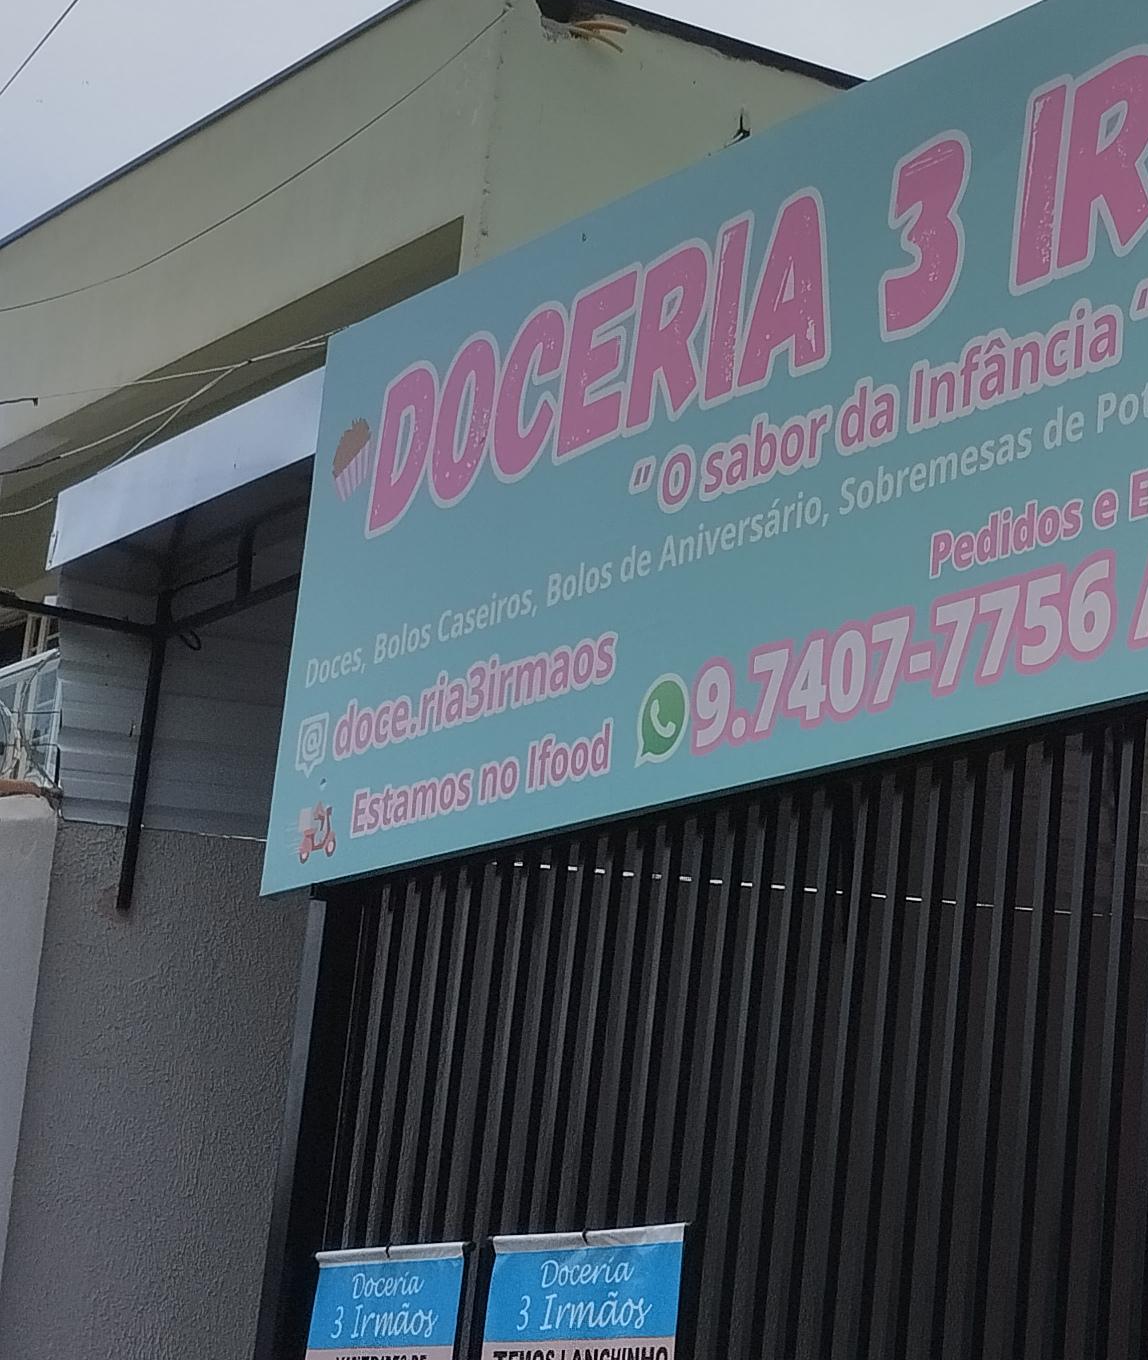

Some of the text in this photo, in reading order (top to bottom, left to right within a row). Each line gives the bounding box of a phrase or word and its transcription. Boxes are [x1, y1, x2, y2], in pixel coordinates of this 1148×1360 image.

[366, 189, 828, 535] DOCERIA
[881, 133, 968, 337] 3
[699, 406, 832, 499] sabor
[837, 376, 899, 456] da
[305, 654, 367, 689] Doces,
[374, 622, 430, 664] Bolos
[438, 587, 538, 640] Caseiros,
[547, 560, 612, 607] Bolos
[620, 546, 651, 583] de
[658, 495, 829, 571] Aniversário,
[840, 426, 1032, 515] Sobremesas
[1043, 406, 1084, 450] de
[930, 495, 1083, 578] Pedidos
[1093, 488, 1118, 529] e
[334, 632, 618, 761] doce.ria3irmaos
[693, 554, 1115, 751] 9.7407-7756
[350, 719, 614, 838] Estamos no Ifood
[331, 1303, 438, 1339] 3 Irmãos
[353, 1272, 425, 1300] Doceria
[516, 1291, 653, 1331] 3 Irmãos
[541, 1257, 635, 1288] Doceria
